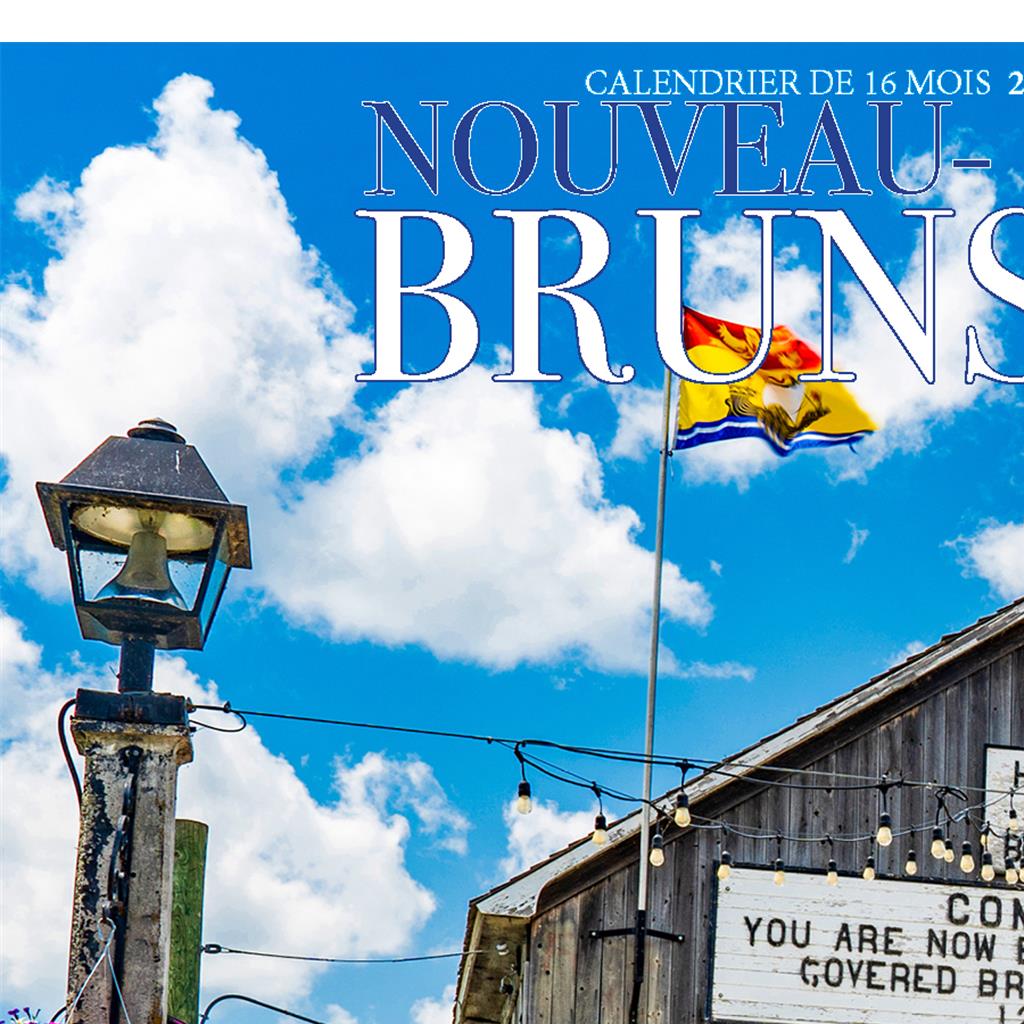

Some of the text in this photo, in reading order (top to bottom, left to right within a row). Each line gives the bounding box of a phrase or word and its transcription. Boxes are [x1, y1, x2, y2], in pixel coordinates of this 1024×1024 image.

[744, 916, 811, 948] YOU
[835, 923, 903, 955] ARE
[927, 929, 996, 962] NOW
[800, 956, 956, 995] COVERED
